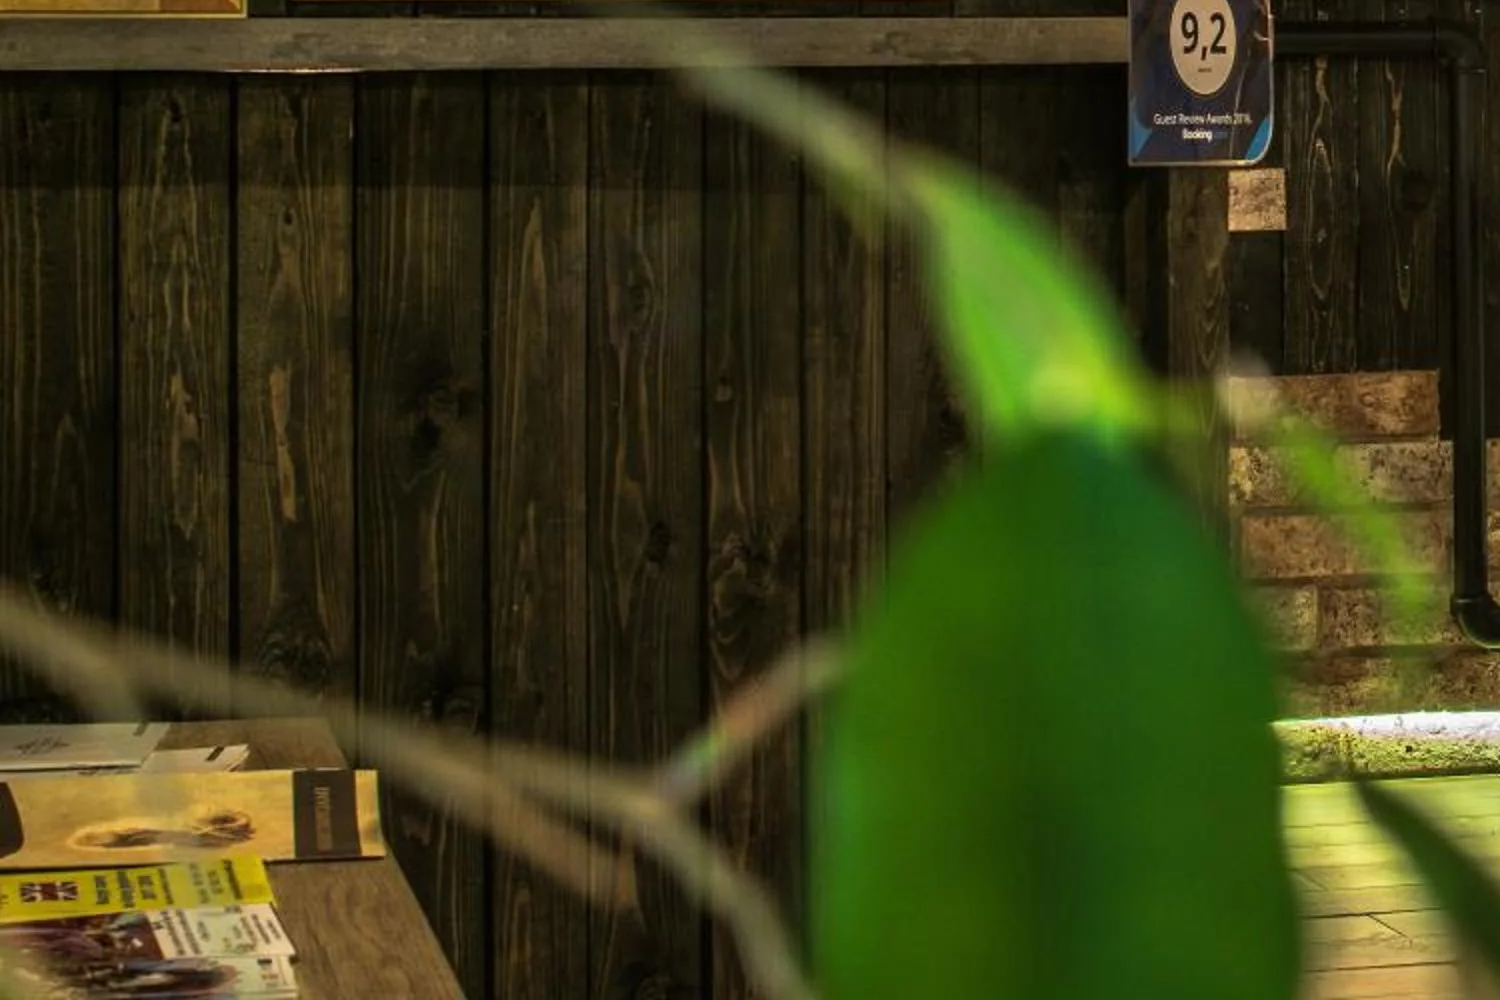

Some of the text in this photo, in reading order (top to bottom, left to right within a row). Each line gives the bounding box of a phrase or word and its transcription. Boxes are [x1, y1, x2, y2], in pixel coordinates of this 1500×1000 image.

[1180, 11, 1227, 61] 9,2
[1153, 113, 1177, 125] Guest
[1178, 113, 1205, 125] Review
